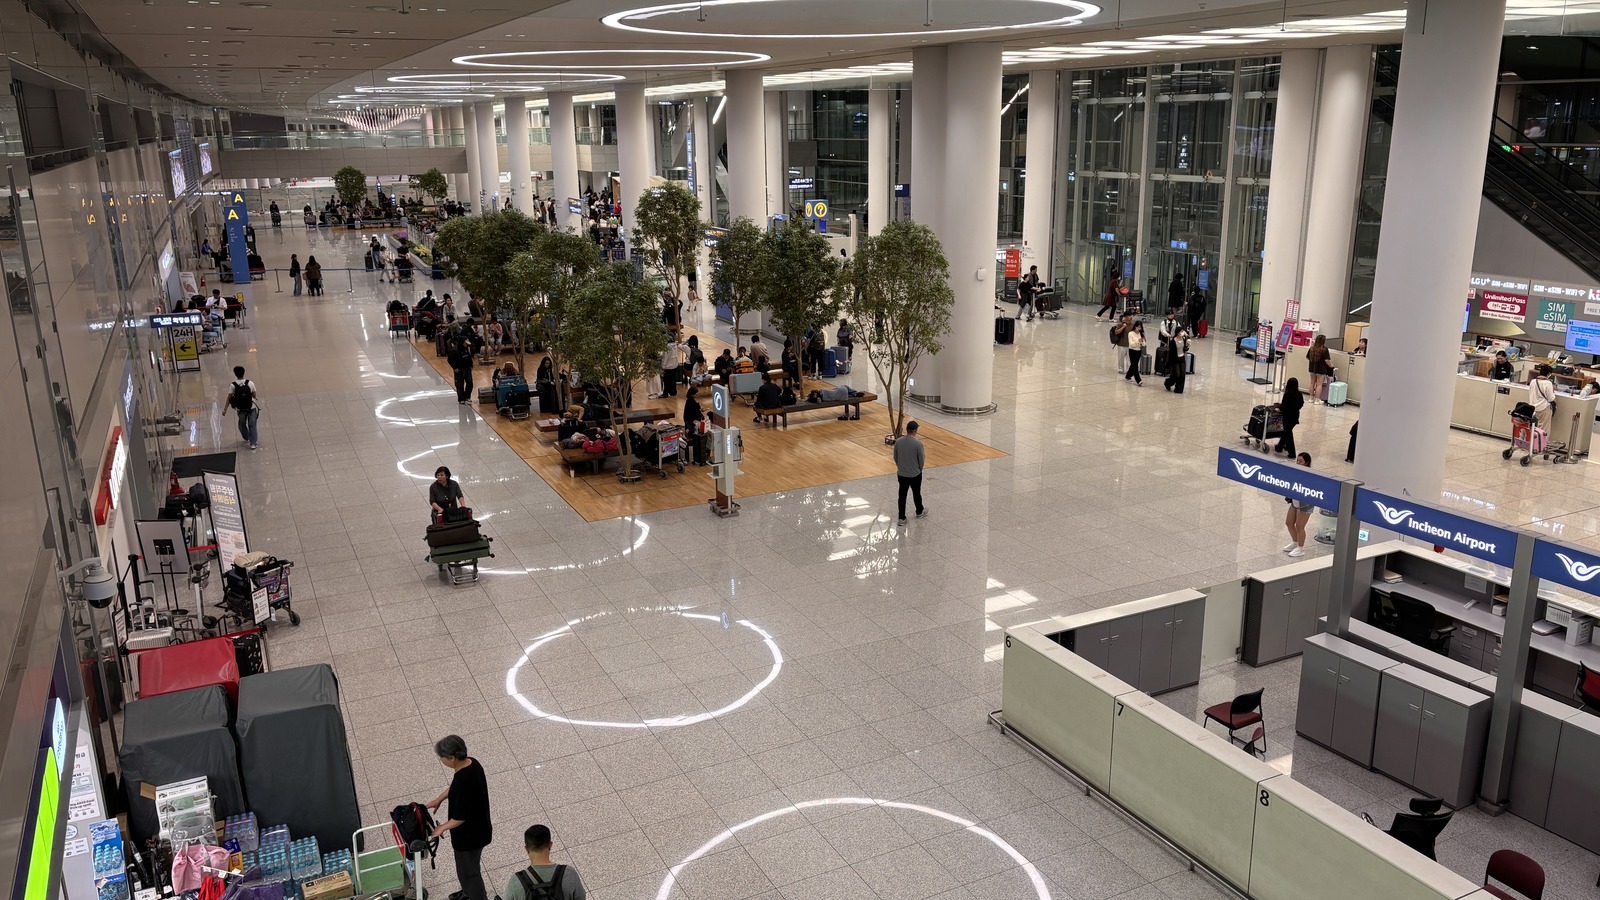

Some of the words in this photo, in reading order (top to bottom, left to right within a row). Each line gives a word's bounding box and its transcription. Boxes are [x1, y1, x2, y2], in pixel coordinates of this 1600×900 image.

[234, 194, 244, 203] A
[228, 209, 239, 220] A
[1471, 277, 1481, 285] LG
[1484, 293, 1512, 303] Unlimited
[1512, 296, 1526, 304] Pass
[1547, 302, 1566, 313] SIM
[173, 316, 190, 324] 화장실
[1543, 311, 1567, 323] eSIM
[173, 329, 193, 338] 24H
[1258, 472, 1291, 490] Incheon
[1292, 483, 1325, 500] Airport
[1409, 517, 1452, 540] Incheon
[1454, 531, 1497, 554] Airport
[1005, 635, 1012, 648] 6
[1117, 703, 1125, 717] 7
[1259, 789, 1270, 807] 8
